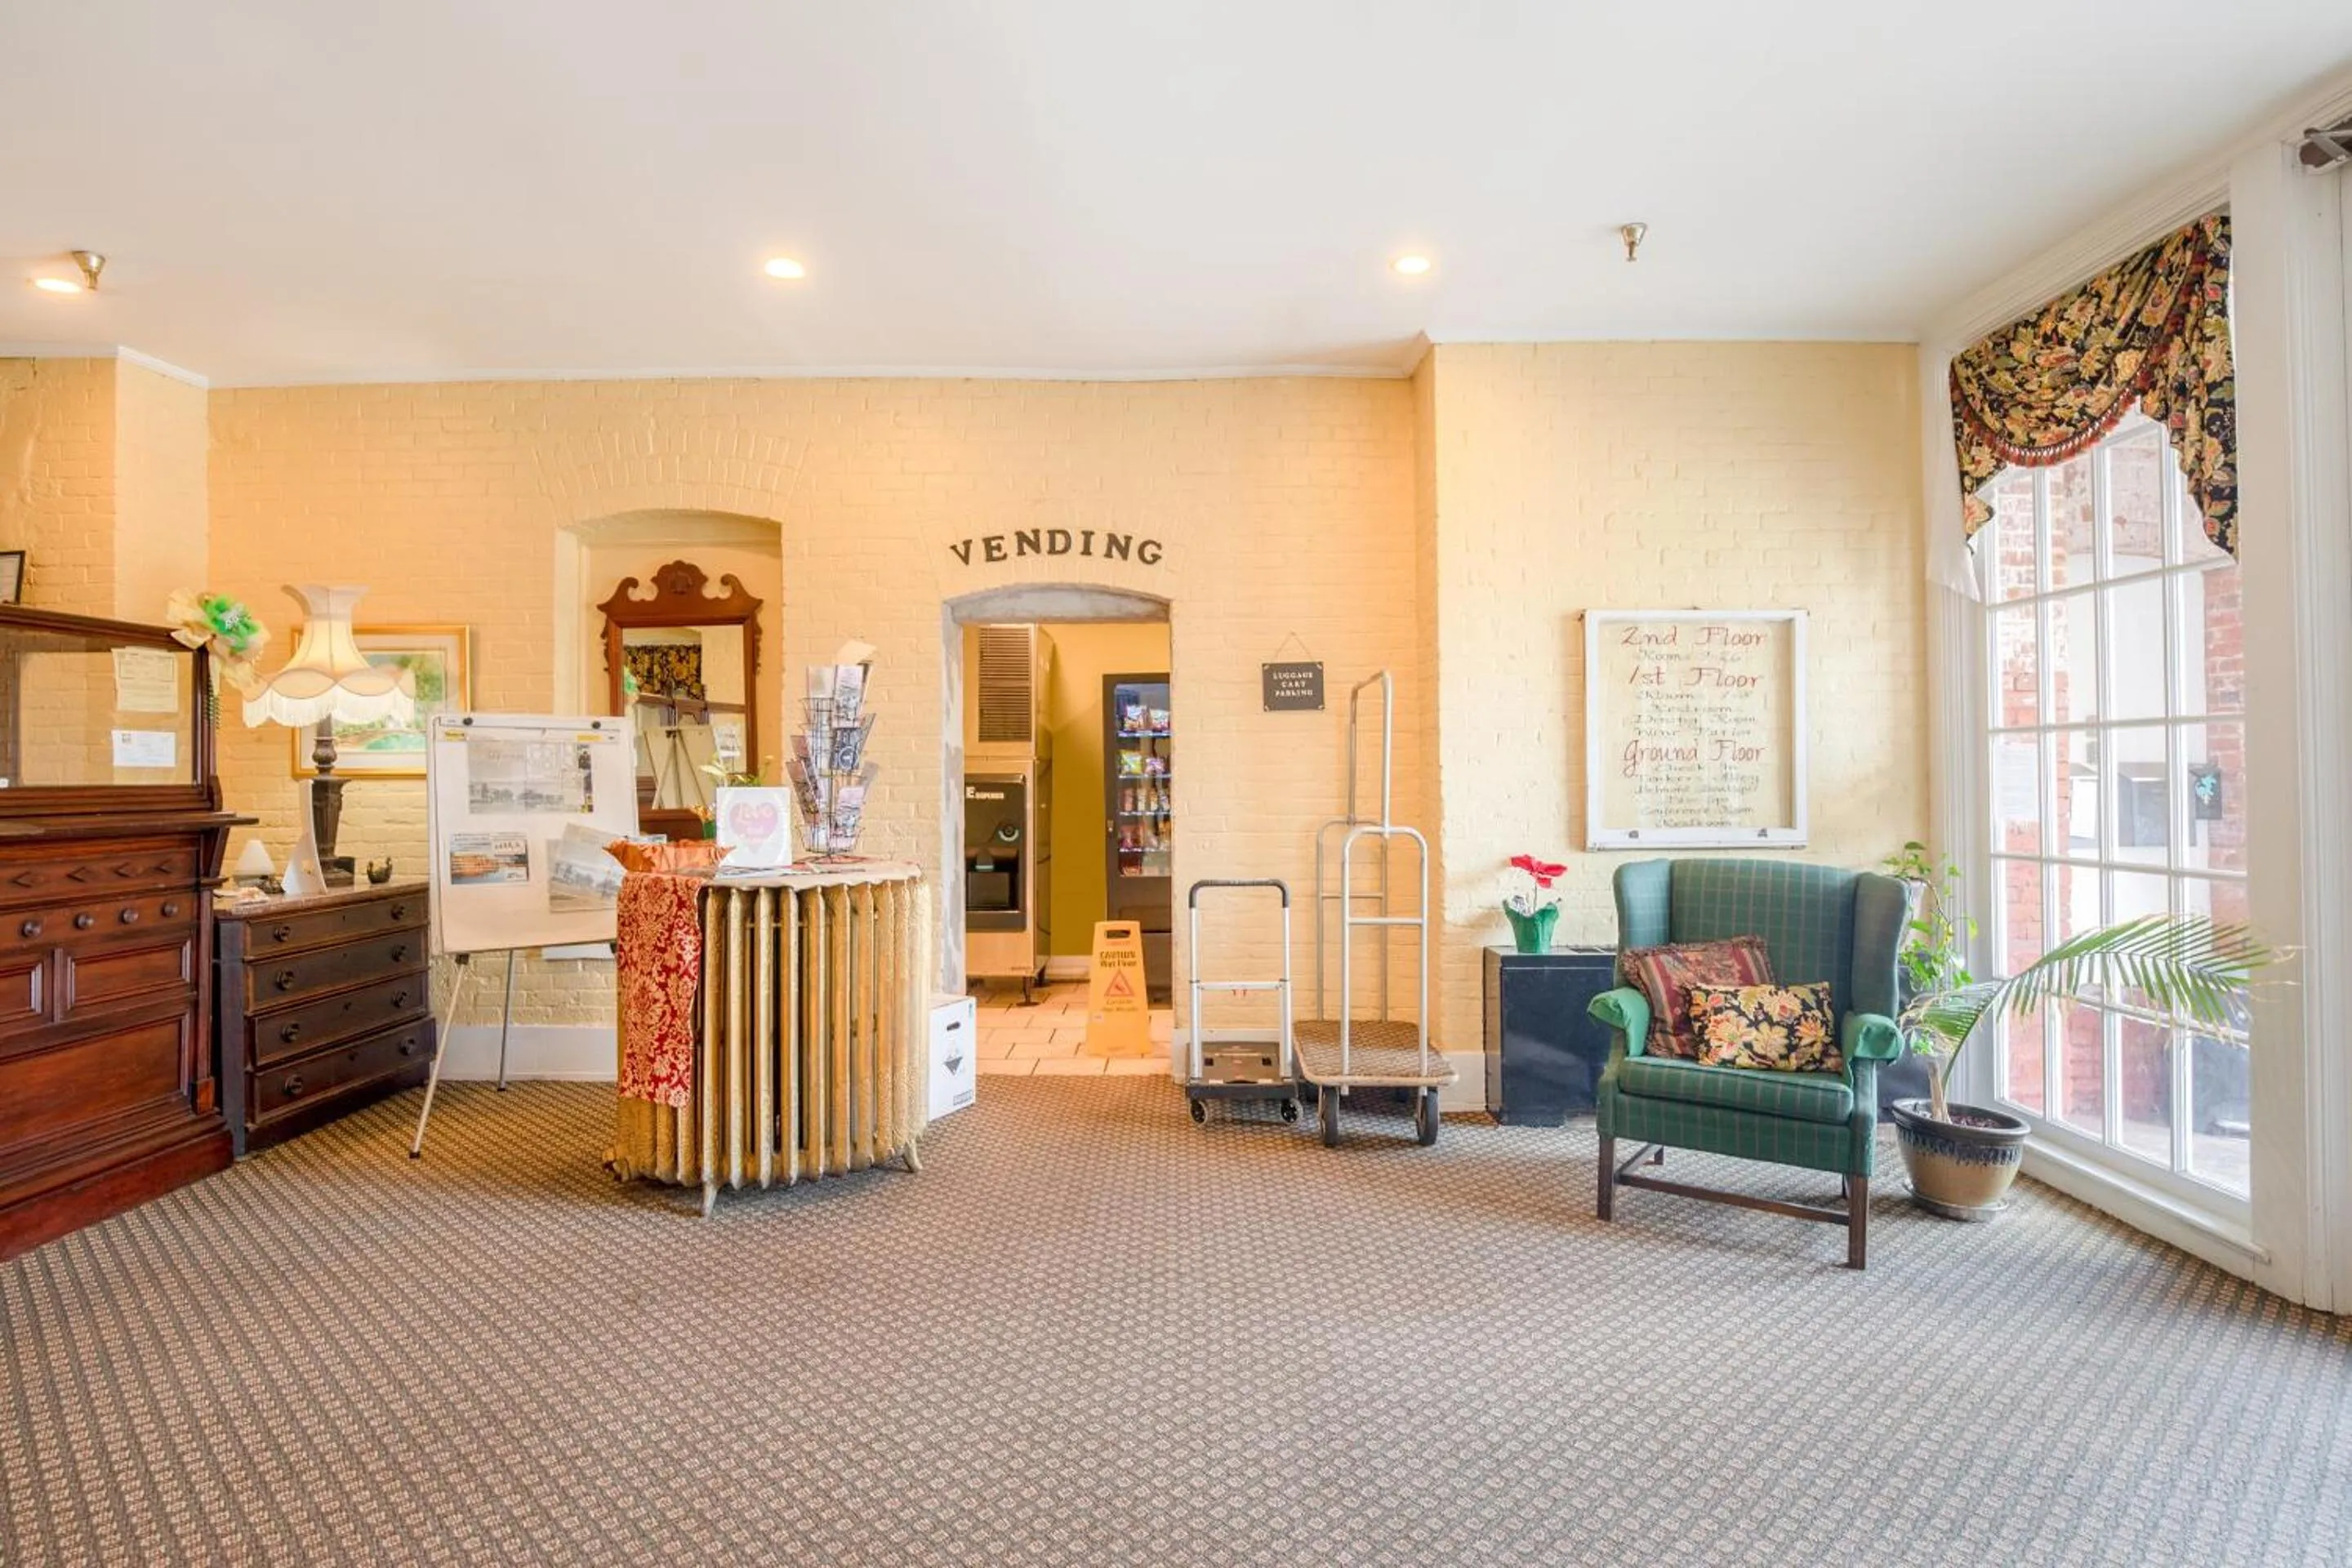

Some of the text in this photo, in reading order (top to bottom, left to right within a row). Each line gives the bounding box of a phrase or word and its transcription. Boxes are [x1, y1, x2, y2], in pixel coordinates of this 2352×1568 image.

[950, 528, 1163, 566] VENDING
[1621, 626, 1766, 647] 2nd Floor
[1628, 666, 1764, 688] 1st Floor
[1710, 739, 1766, 761] Floor
